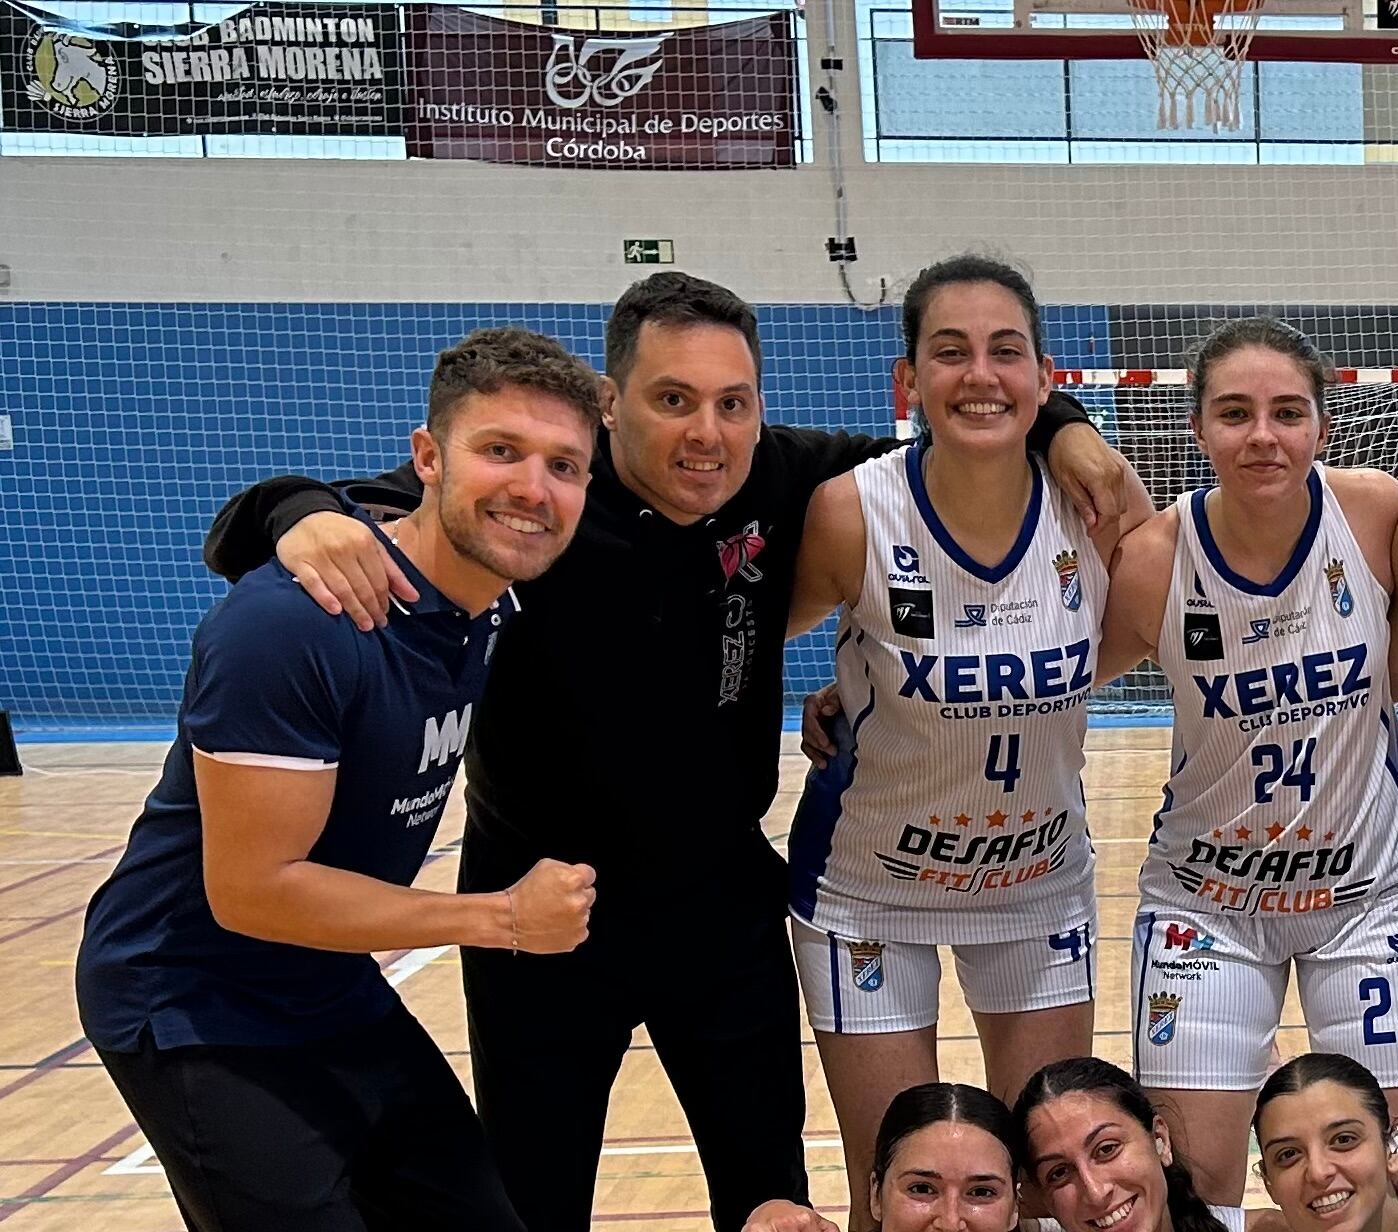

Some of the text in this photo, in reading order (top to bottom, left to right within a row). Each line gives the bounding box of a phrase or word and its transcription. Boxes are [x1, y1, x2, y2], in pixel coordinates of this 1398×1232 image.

[220, 16, 375, 44] BADMINTON
[142, 46, 384, 85] SIERRA MORENA
[419, 98, 785, 138] Instituto Municipal de Deportes
[546, 137, 647, 161] Córdoba
[991, 613, 1033, 627] de Cádiz
[1274, 628, 1286, 638] de
[898, 638, 1093, 704] XEREZ
[1192, 642, 1372, 719] XEREZ
[939, 686, 1092, 720] CLUB DEPORTIVO
[1276, 691, 1371, 726] DEPORTIVO
[984, 734, 1021, 793] 4
[1251, 737, 1318, 803] 24
[896, 810, 1069, 866] DESAFIO
[919, 858, 1051, 890] FIT CLUB
[1185, 838, 1355, 883] DESAFIO
[1196, 876, 1336, 914] FIT CLUB
